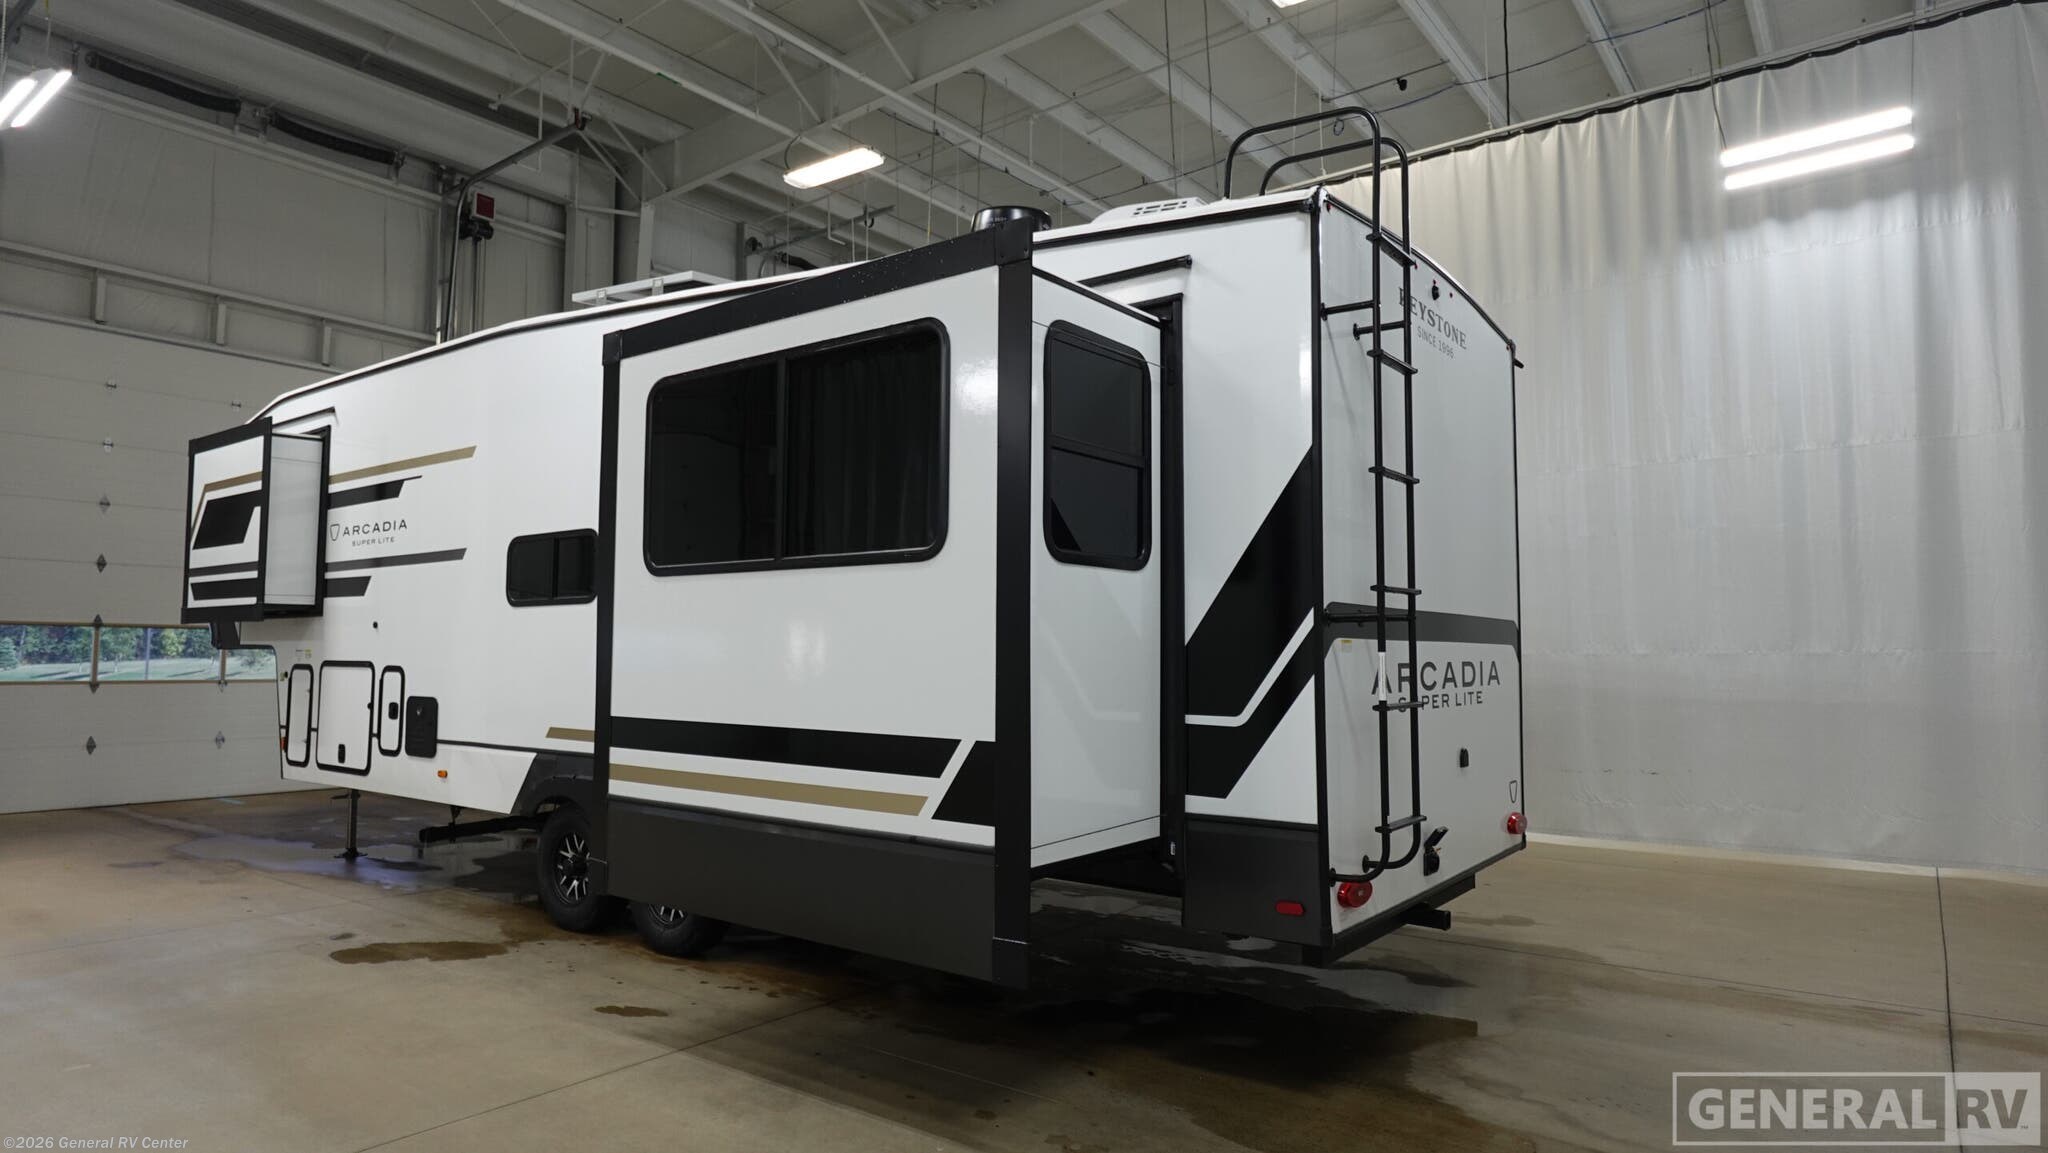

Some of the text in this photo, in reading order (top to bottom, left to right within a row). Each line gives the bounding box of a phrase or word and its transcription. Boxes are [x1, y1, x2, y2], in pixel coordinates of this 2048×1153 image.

[1417, 326, 1436, 348] SINCE
[342, 519, 408, 537] ARCADIA
[352, 536, 395, 547] SUPER LITE
[1398, 691, 1483, 713] SPER LITE
